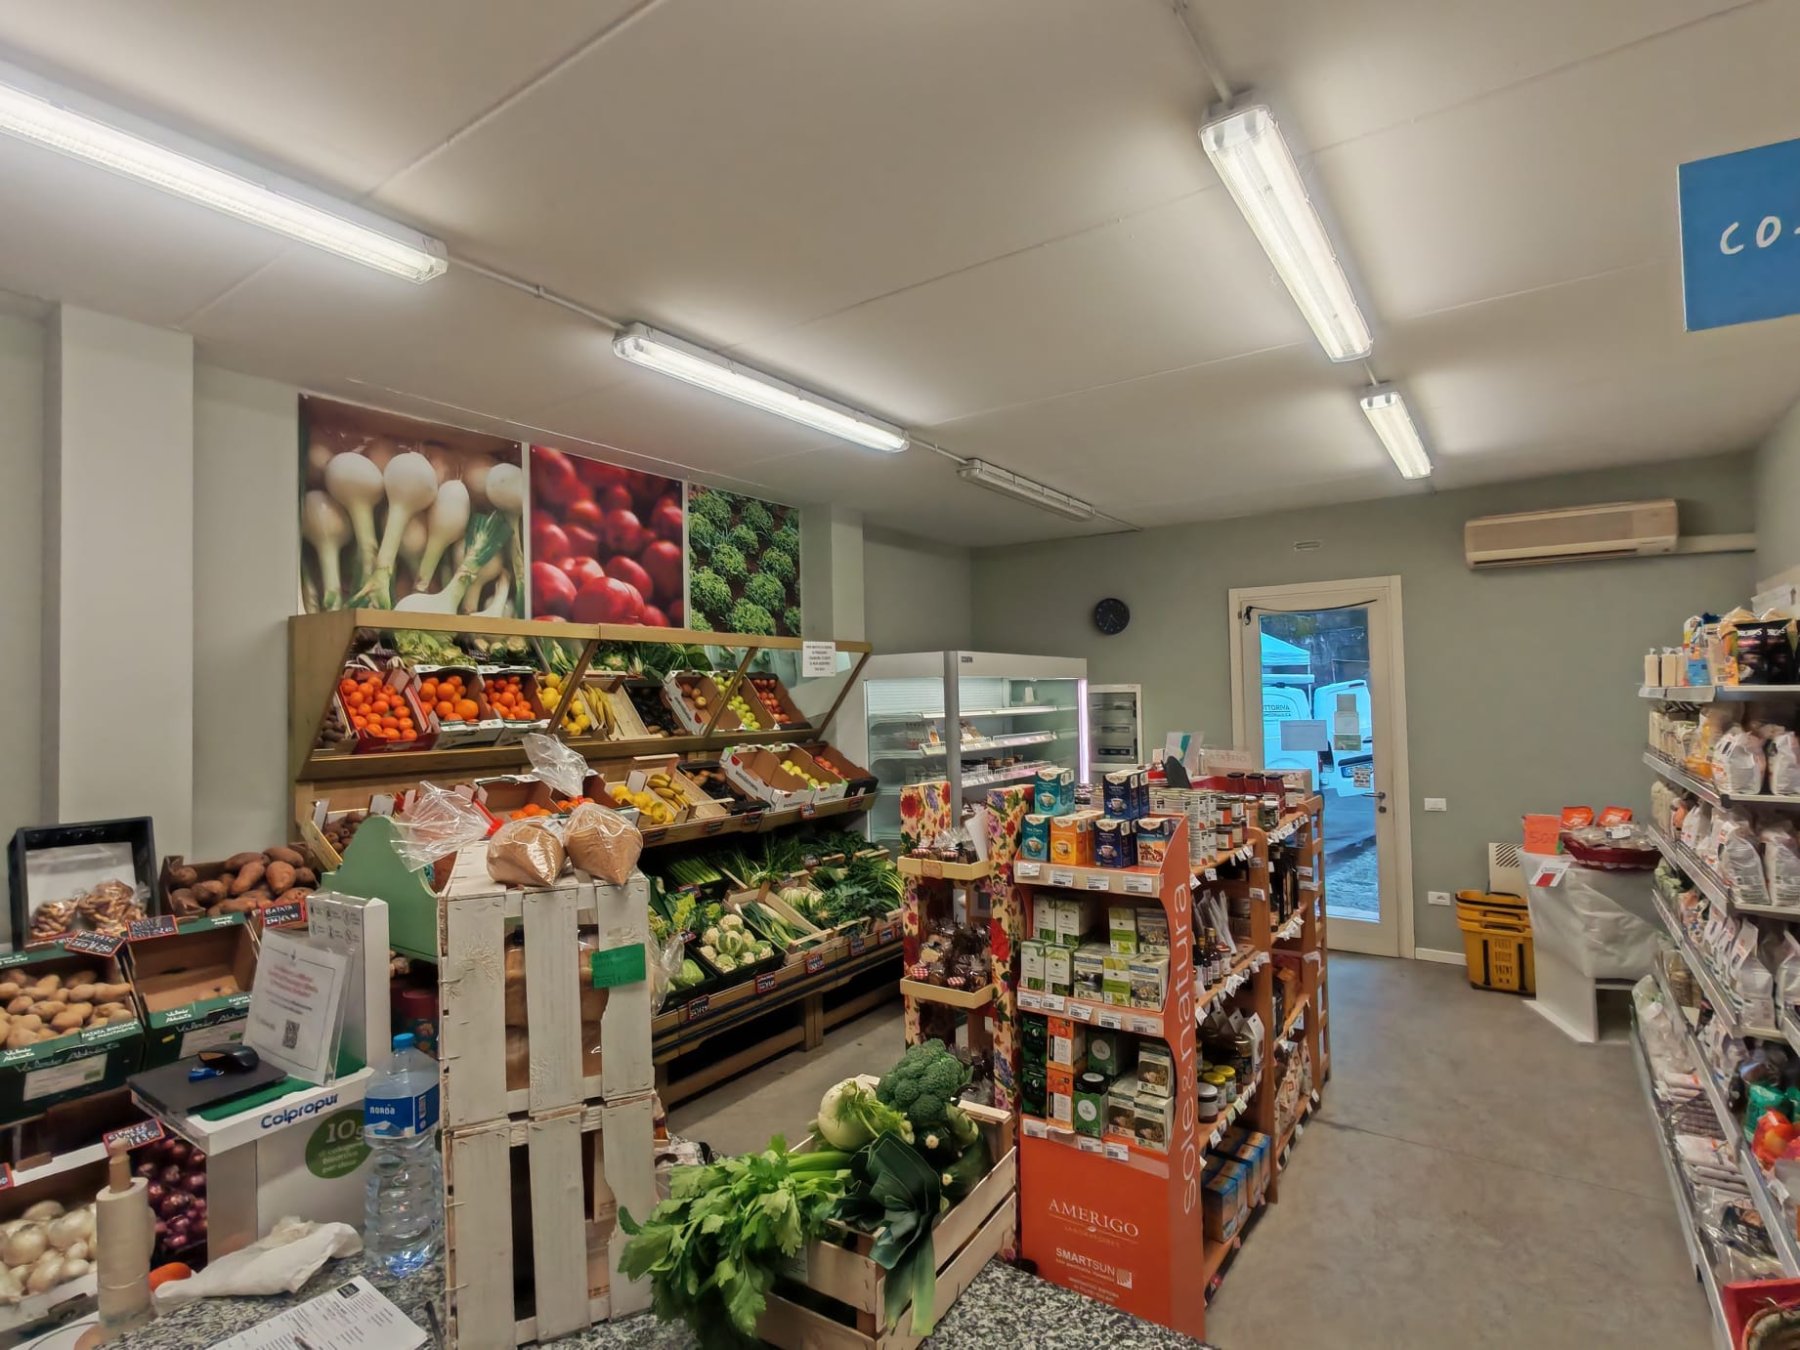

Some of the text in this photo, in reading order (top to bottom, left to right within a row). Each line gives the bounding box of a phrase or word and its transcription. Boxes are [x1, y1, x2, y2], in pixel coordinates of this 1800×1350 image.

[261, 1093, 339, 1130] Colpropur
[1048, 1198, 1140, 1238] AMERIGO
[1055, 1247, 1116, 1277] SMARTSUN
